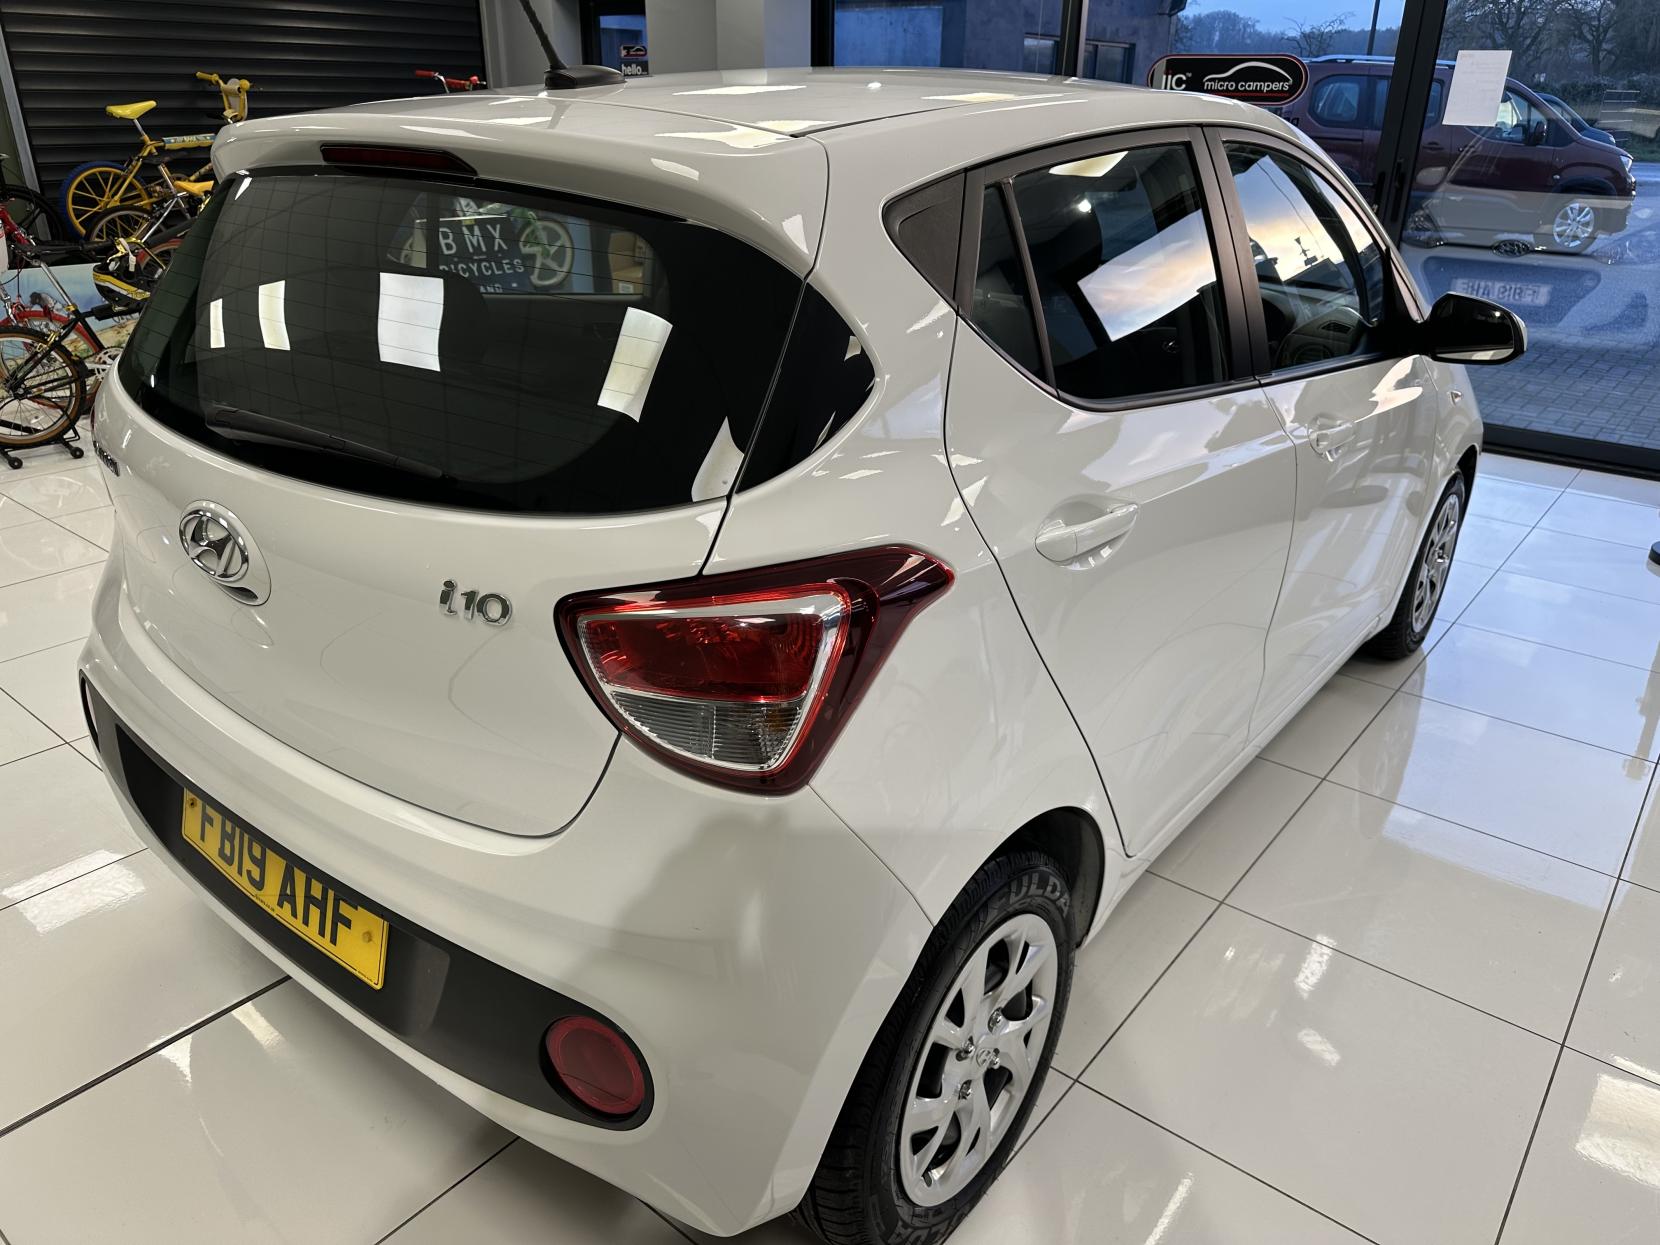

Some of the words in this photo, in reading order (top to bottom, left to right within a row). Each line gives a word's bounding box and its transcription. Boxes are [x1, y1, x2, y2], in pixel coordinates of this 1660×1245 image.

[1204, 80, 1235, 91] micro
[1238, 81, 1290, 93] campers
[438, 223, 509, 255] BMX
[440, 579, 513, 626] i10
[200, 800, 267, 892] FB19
[276, 860, 360, 947] AHF
